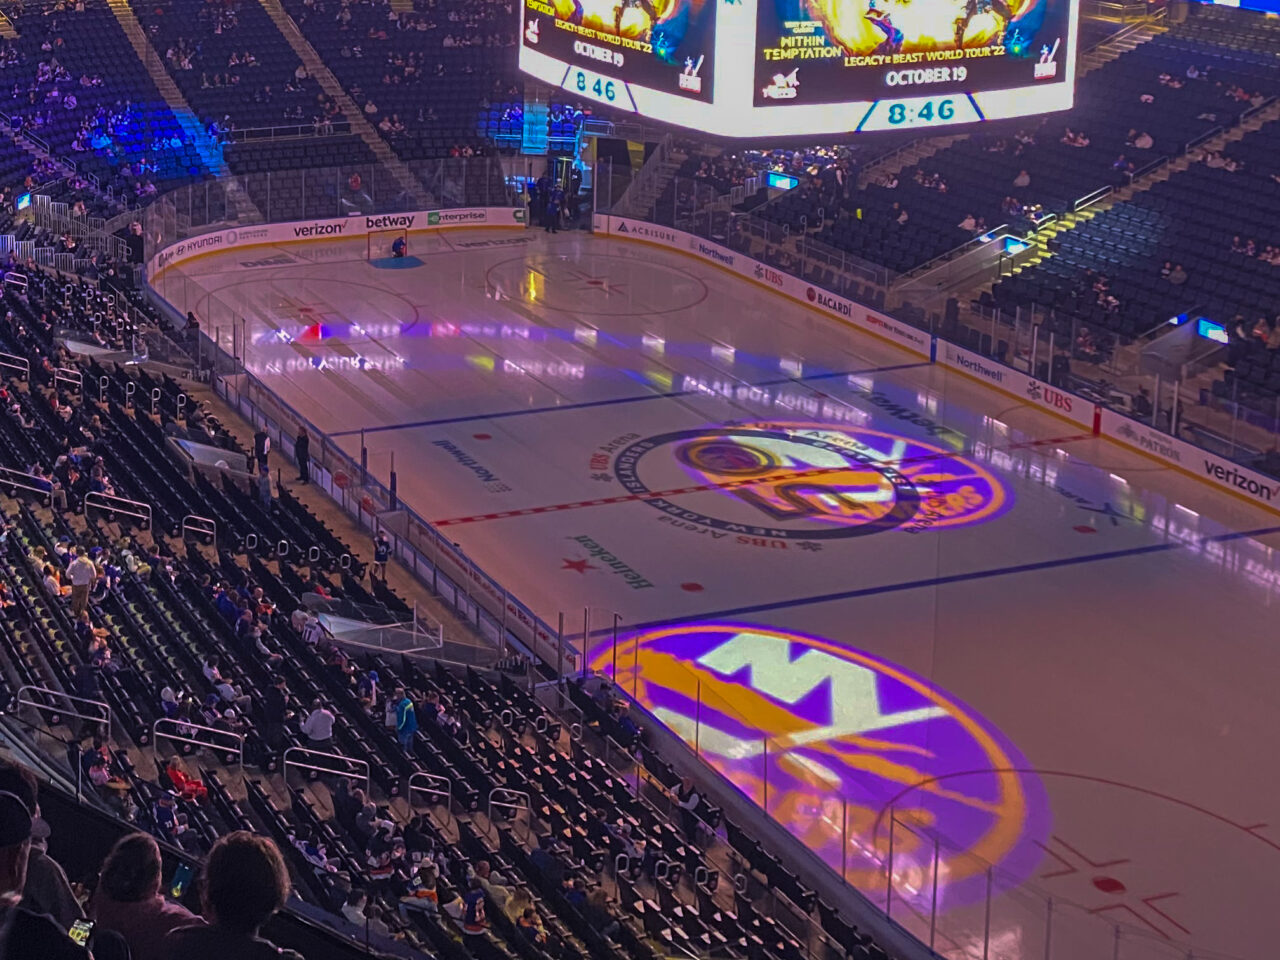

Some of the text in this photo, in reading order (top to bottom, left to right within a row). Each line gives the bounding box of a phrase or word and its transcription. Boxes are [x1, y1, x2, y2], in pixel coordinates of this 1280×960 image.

[764, 45, 843, 61] TEMPTATION
[780, 35, 825, 48] WITHIN
[844, 54, 885, 68] LEGACY
[893, 51, 924, 65] BEAST
[926, 48, 964, 63] WORLD
[966, 47, 991, 60] TOUR
[886, 66, 968, 87] OCTOBER 19
[887, 98, 956, 126] 8:46
[294, 221, 342, 238] verizon
[366, 214, 416, 229] betway
[187, 235, 223, 252] HYUNDAI
[632, 226, 676, 243] ACRISURE
[698, 243, 735, 266] Northwell
[764, 269, 784, 287] UBS
[956, 353, 1003, 383] Northwell
[1043, 387, 1073, 413] UBS
[432, 439, 499, 483] Northwell
[588, 431, 642, 472] UBS Arena
[619, 441, 655, 493] ISLANDERS
[1204, 459, 1272, 501] verizon
[651, 498, 713, 526] YORK
[565, 534, 657, 590] Heineken
